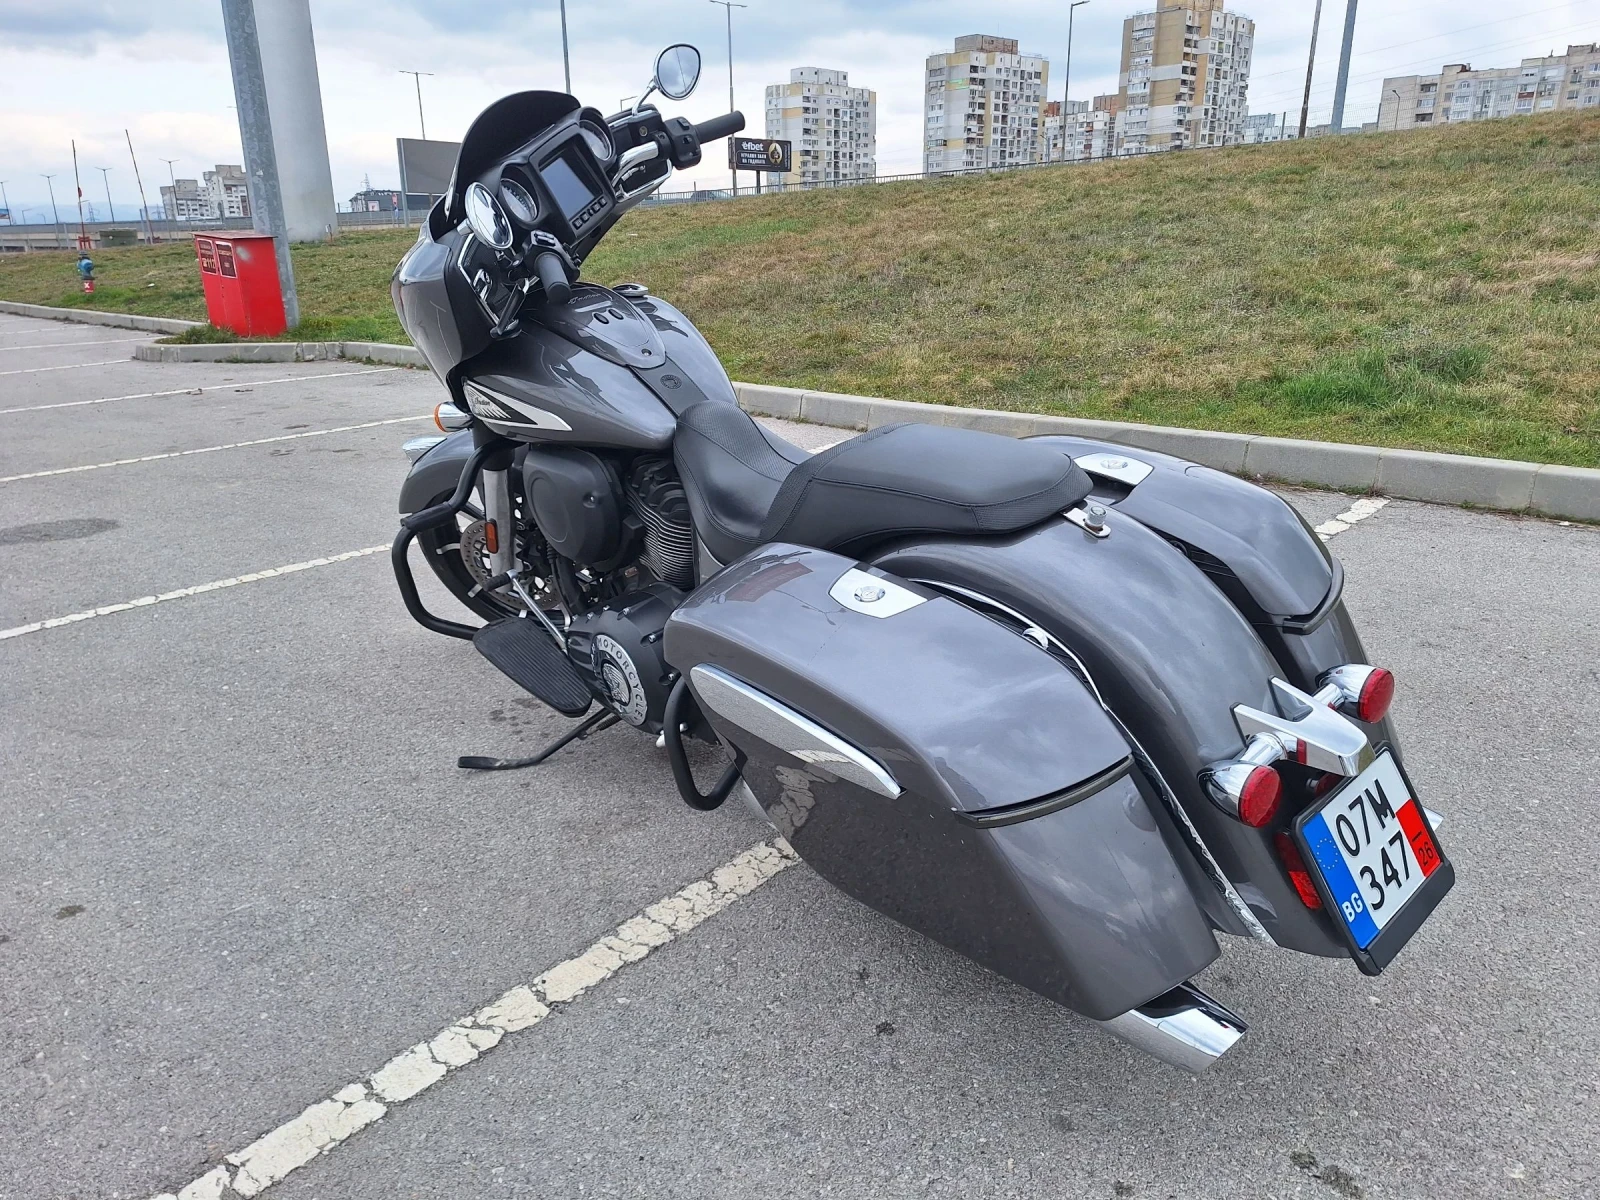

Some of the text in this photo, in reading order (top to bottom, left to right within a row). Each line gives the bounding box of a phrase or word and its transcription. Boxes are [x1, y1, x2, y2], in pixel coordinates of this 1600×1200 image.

[742, 141, 764, 151] efbet
[597, 637, 643, 718] MOTORCYCLE
[1335, 779, 1396, 856] 07M
[1360, 830, 1410, 911] 347
[1418, 841, 1434, 866] 26
[1342, 892, 1364, 922] BG
